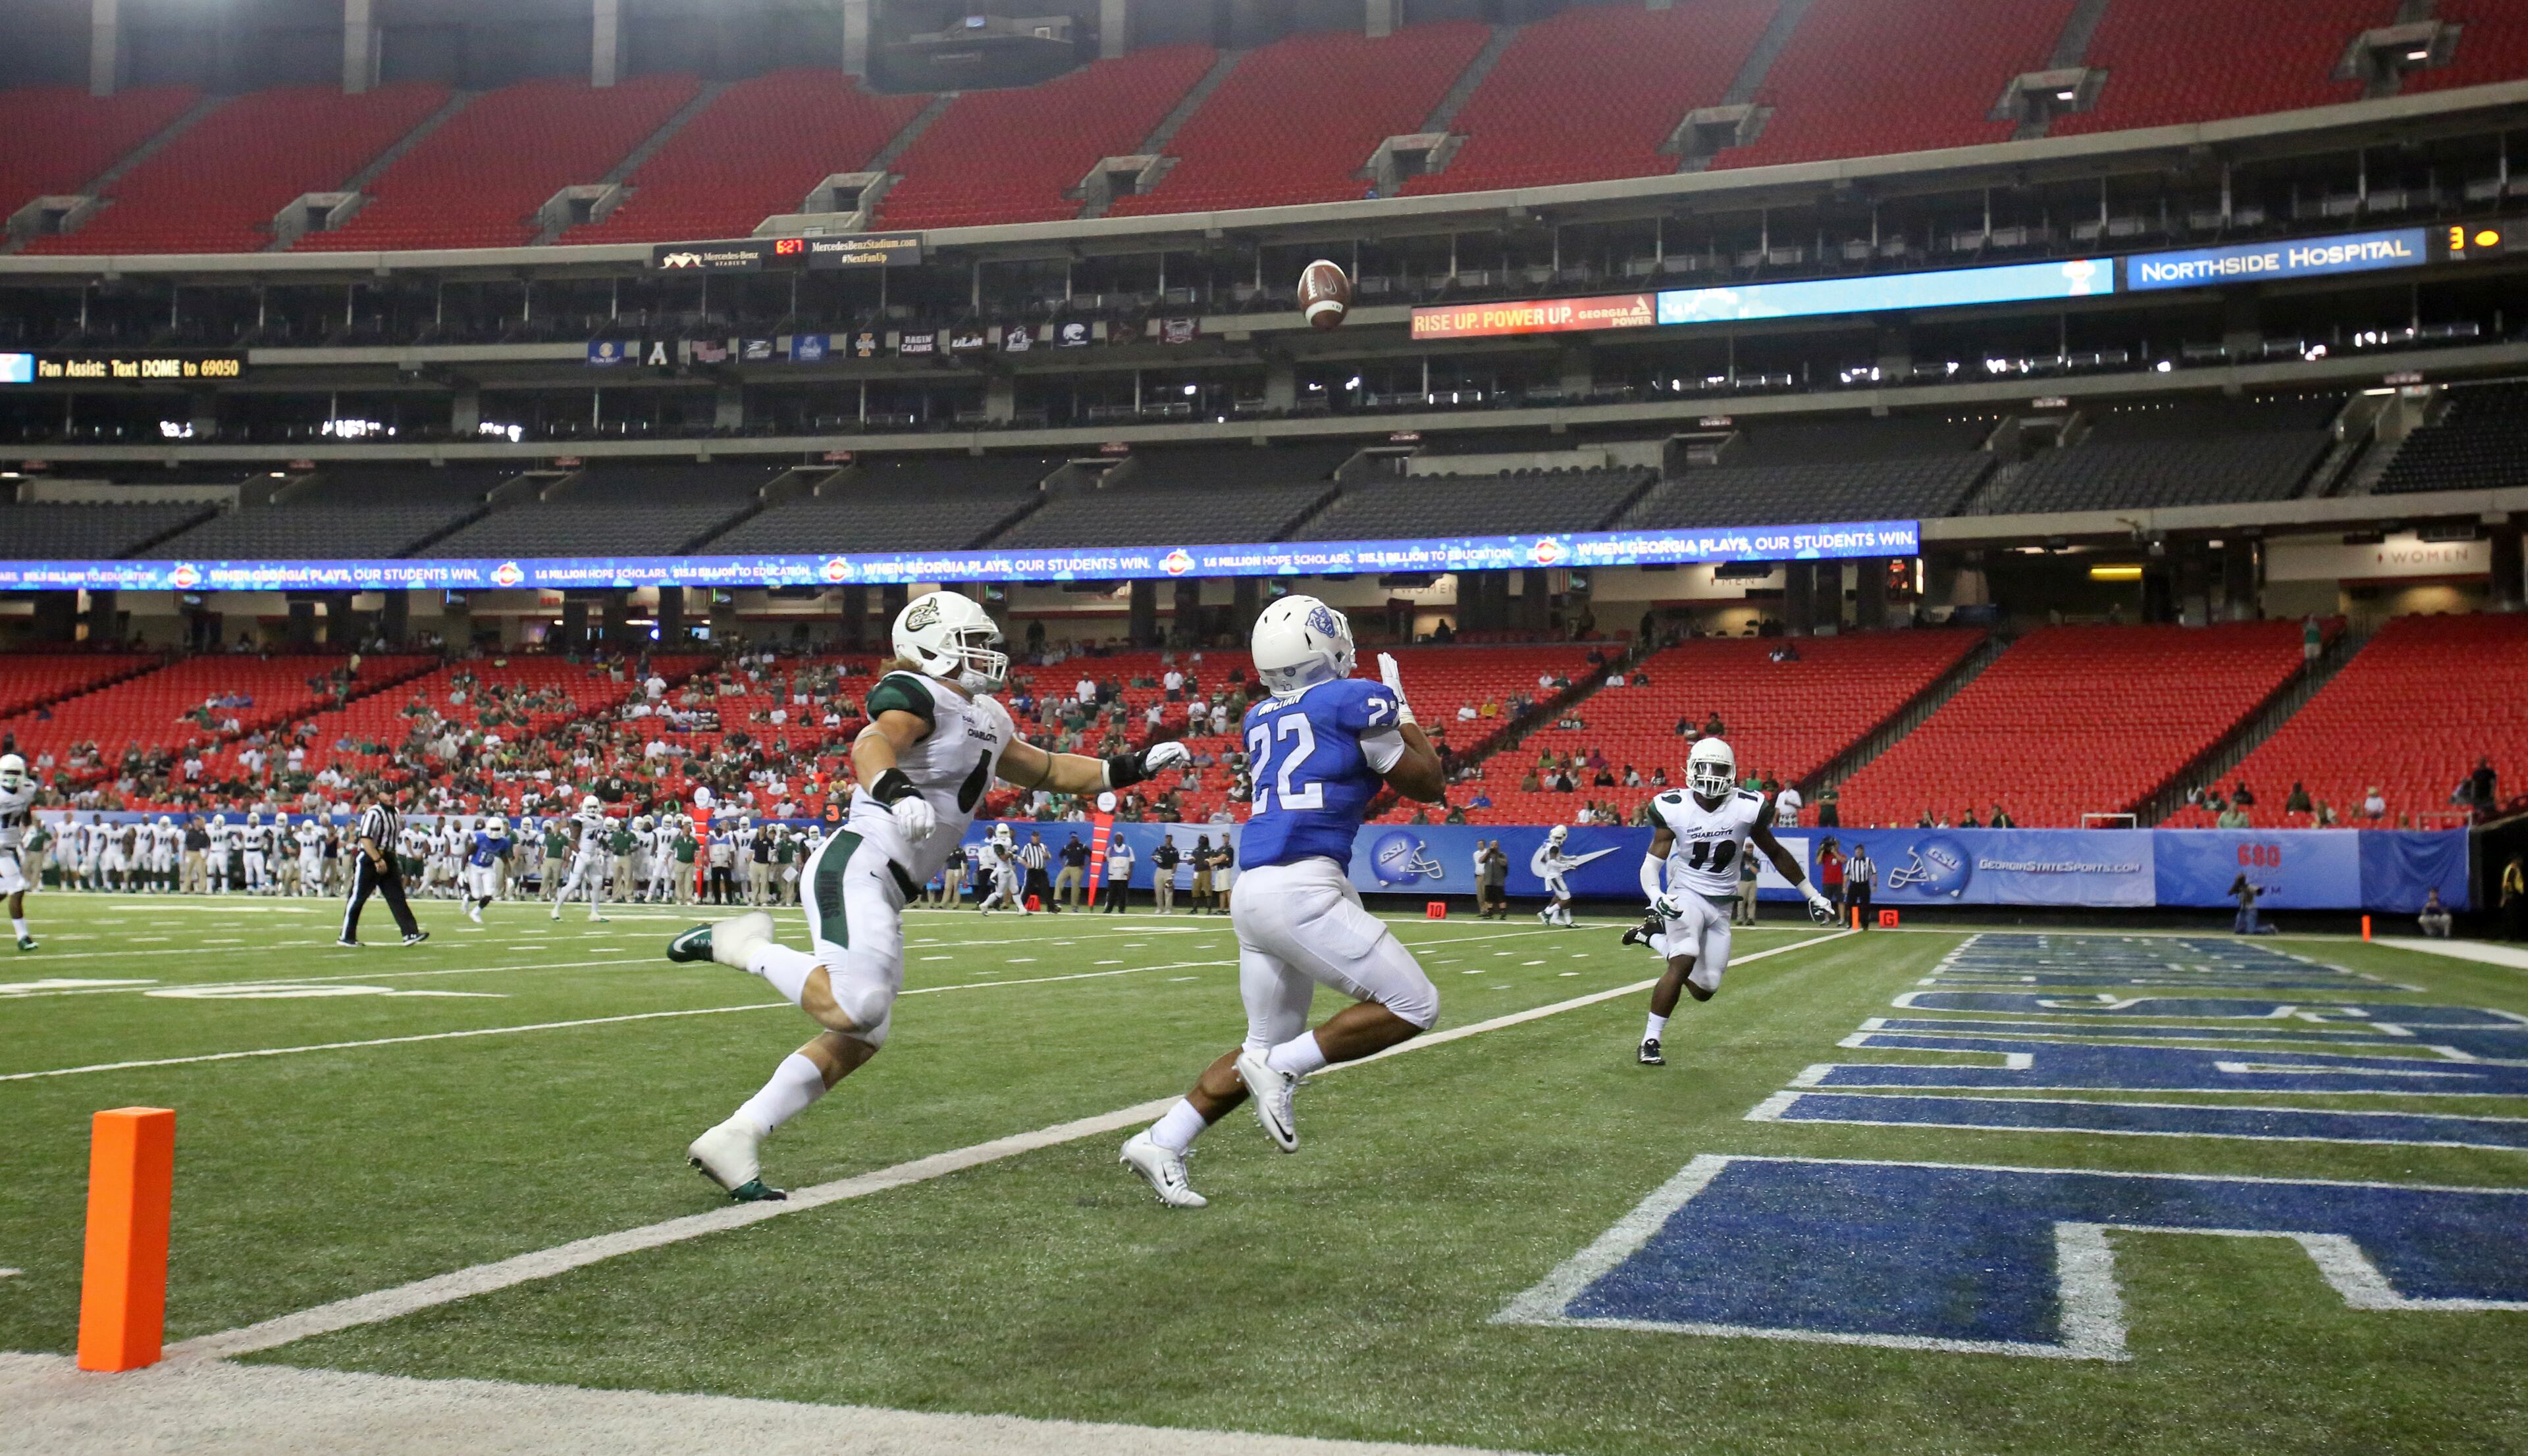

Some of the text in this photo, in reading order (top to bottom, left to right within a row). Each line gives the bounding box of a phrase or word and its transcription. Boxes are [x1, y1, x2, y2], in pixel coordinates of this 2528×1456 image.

[2449, 226, 2465, 250] 3
[776, 239, 803, 255] 6:27
[703, 251, 759, 261] Mercedes-Benz
[841, 253, 888, 264] #NextFanUp
[1413, 305, 1574, 332] RISE UP. POWER UP.
[1578, 307, 1629, 320] GEORGIA
[1612, 315, 1652, 326] POWER
[38, 359, 239, 377] Fan Assist: Text DOME to 69050
[1577, 542, 1624, 557] WHEN
[1627, 539, 1697, 555] GEORGIA
[1700, 537, 1752, 555] PLAYS,
[1754, 536, 1790, 550] OUR
[1793, 533, 1875, 550] STUDENTS
[1878, 531, 1917, 546] WIN.
[1203, 558, 1217, 567] 1.6
[1219, 556, 1261, 567] MILLION
[1263, 555, 1292, 565] HOPE
[1294, 554, 1354, 565] SCHOLARS.
[1385, 552, 1429, 563] BILLION
[1431, 551, 1445, 561] TO
[2390, 548, 2469, 563] WOMEN
[535, 569, 548, 579] 1.6
[549, 569, 587, 579] MILLION
[588, 569, 614, 579] HOPE
[616, 568, 669, 579] SCHOLARS.
[698, 567, 735, 577] BILLION
[737, 567, 750, 577] TO
[862, 562, 904, 575] WHEN
[907, 561, 965, 575] GEORGIA
[968, 560, 1013, 574] PLAYS,
[1015, 559, 1045, 571] OUR
[1047, 558, 1117, 571] STUDENTS
[1120, 557, 1151, 569] WIN.
[210, 569, 250, 582] WHEN
[252, 569, 307, 582] GEORGIA
[310, 569, 352, 583] PLAYS,
[354, 569, 381, 581] OUR
[384, 568, 449, 581] STUDENTS
[451, 568, 480, 581] WIN.
[1249, 712, 1324, 816] 22
[826, 804, 840, 821] 3
[1691, 829, 1733, 839] CHARLOTTE
[1381, 841, 1408, 864] GSU
[1688, 840, 1737, 873] 19
[1925, 846, 1962, 870] GSU
[2237, 843, 2281, 868] 680
[1430, 904, 1442, 918] 10
[1883, 912, 1895, 925] G
